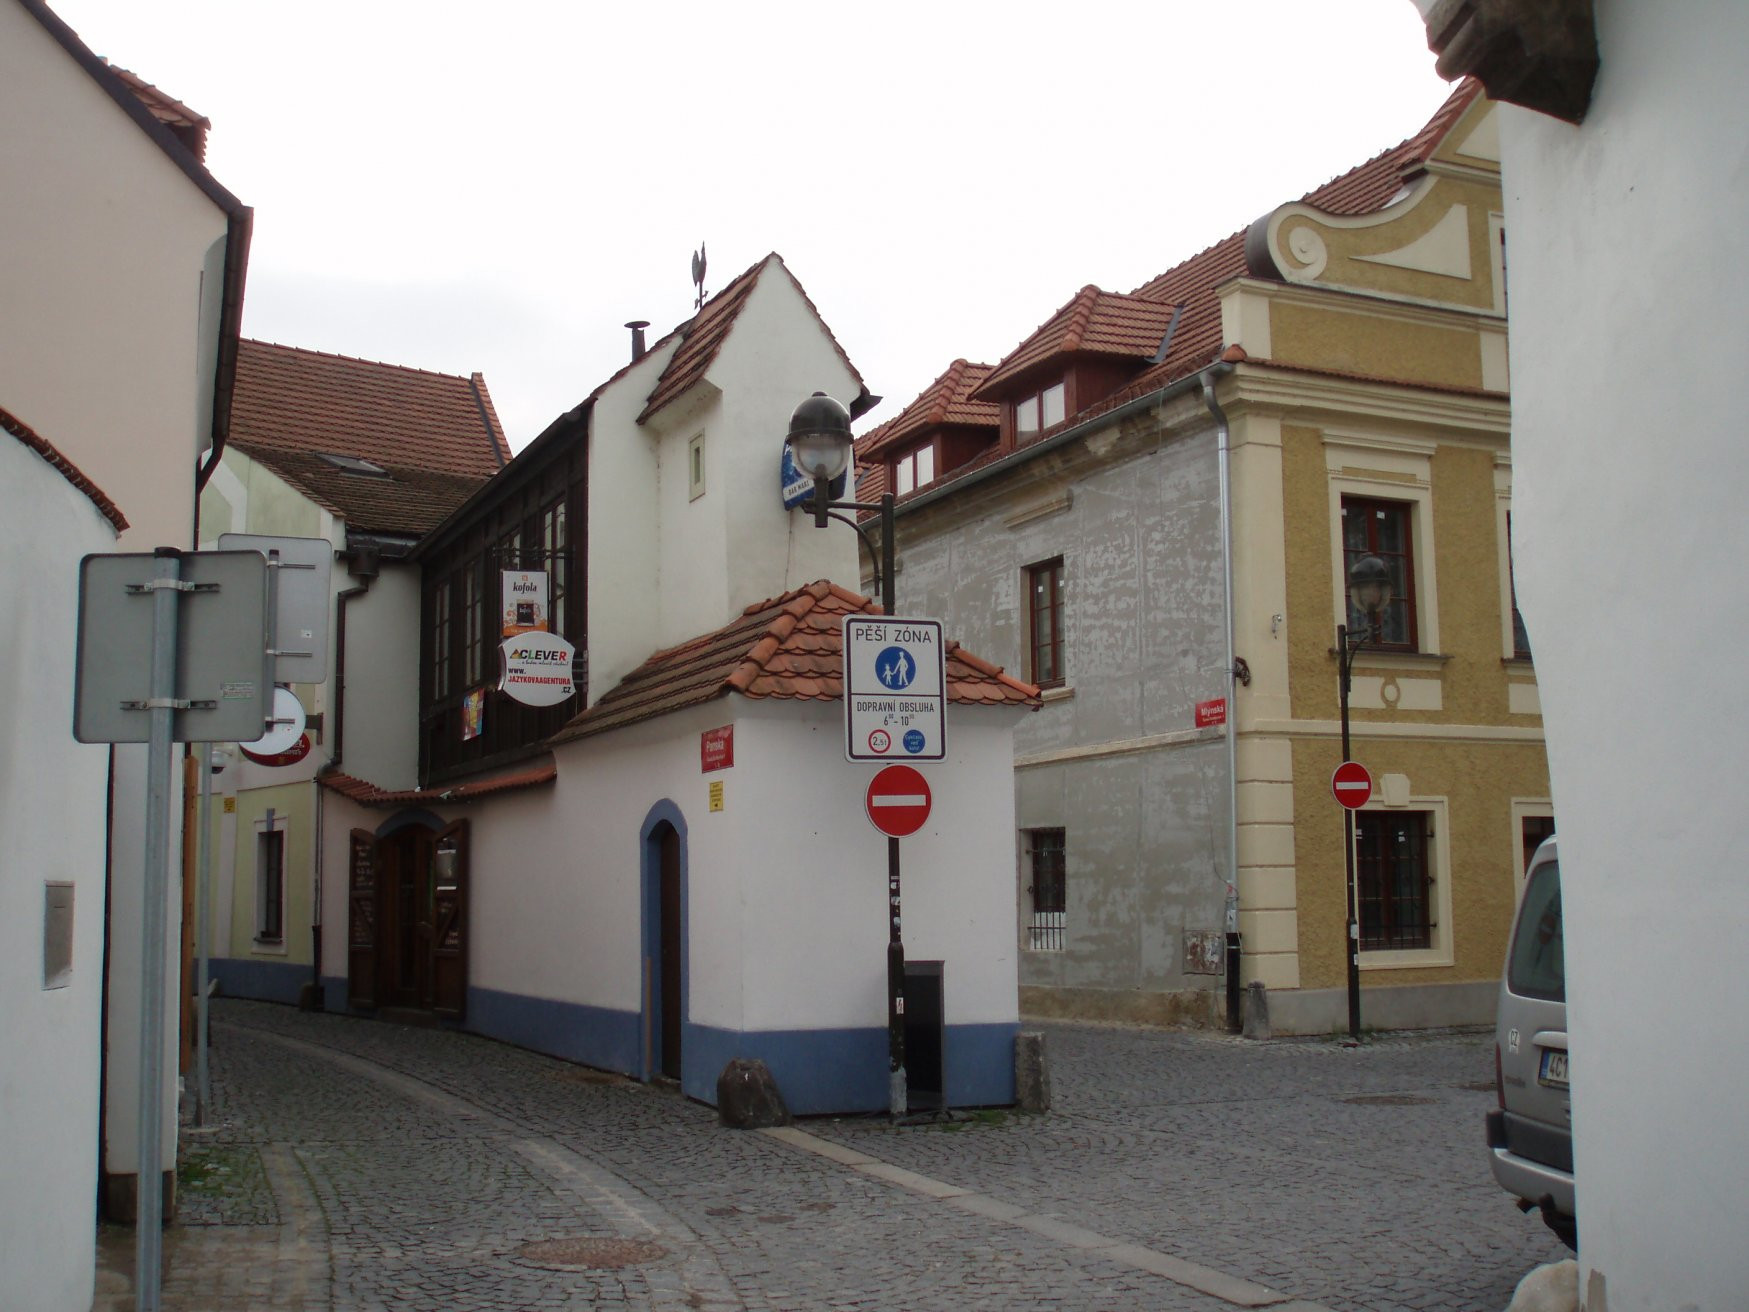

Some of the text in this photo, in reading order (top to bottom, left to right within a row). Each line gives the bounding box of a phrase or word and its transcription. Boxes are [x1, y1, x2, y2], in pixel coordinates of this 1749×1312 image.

[512, 581, 537, 594] kofola
[856, 625, 932, 643] PĚŠÍ ZÓNA
[520, 649, 567, 661] CLEVER
[508, 675, 571, 685] JAZYKOVAAGENTURA
[857, 700, 934, 713] DOPRAVNÍ OBSLUHA
[1201, 704, 1224, 717] Mlýnská
[1511, 1030, 1518, 1046] CZ
